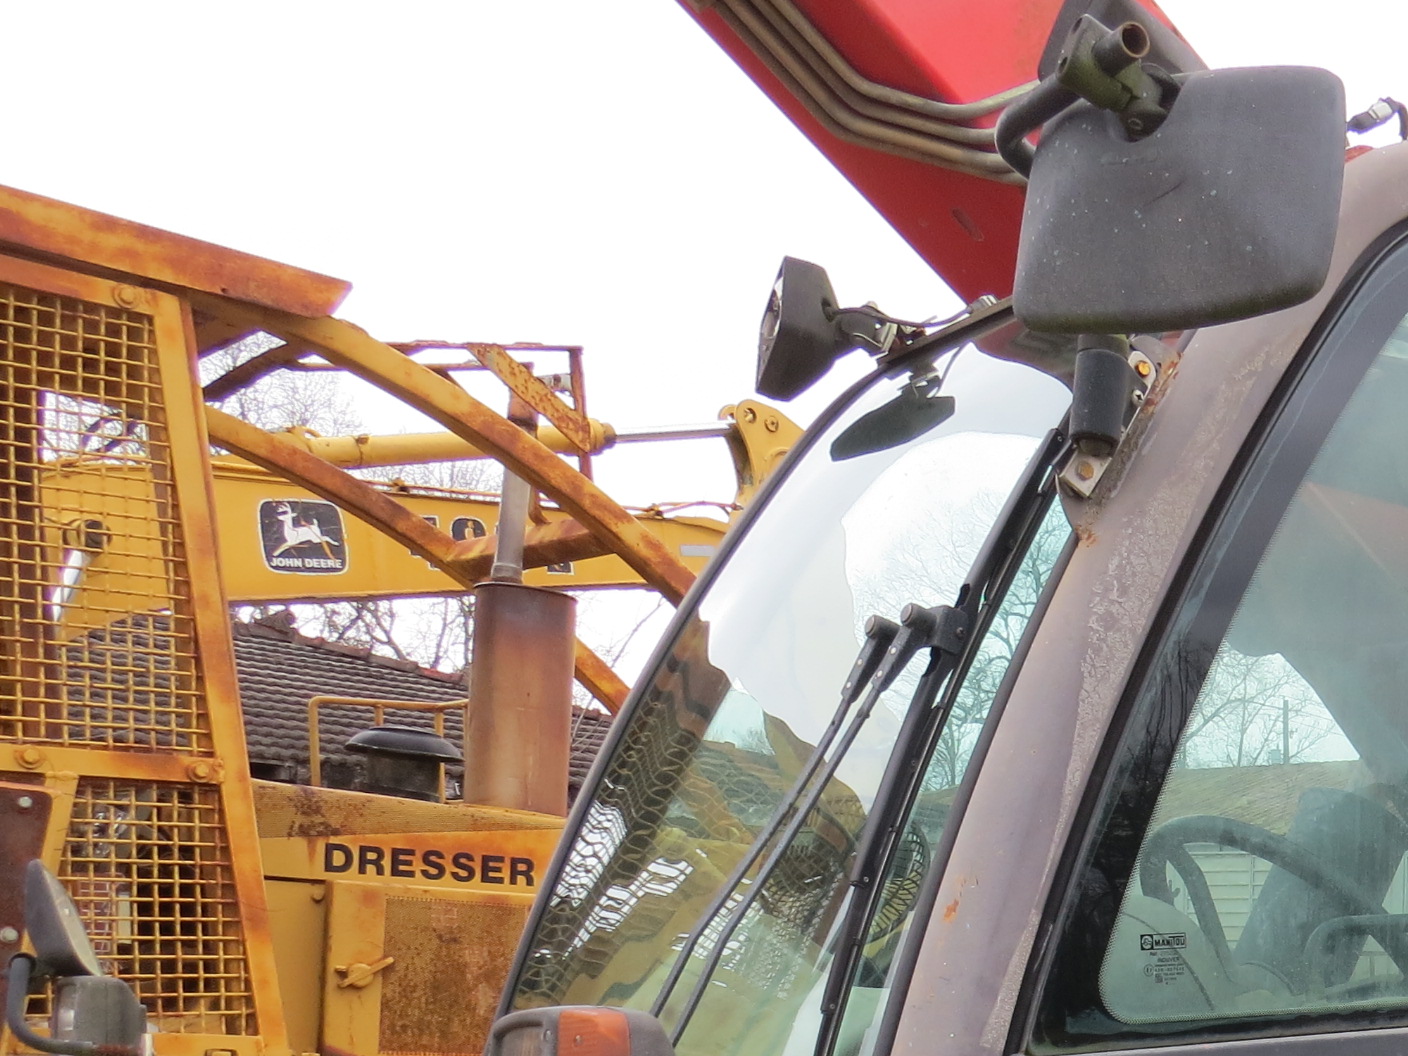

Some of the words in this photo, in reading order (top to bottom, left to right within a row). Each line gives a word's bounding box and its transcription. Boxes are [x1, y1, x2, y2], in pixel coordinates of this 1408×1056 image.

[270, 557, 303, 567] JOHN
[304, 558, 343, 569] DEERE
[323, 842, 536, 887] DRESSER
[1155, 935, 1185, 948] MANITOU
